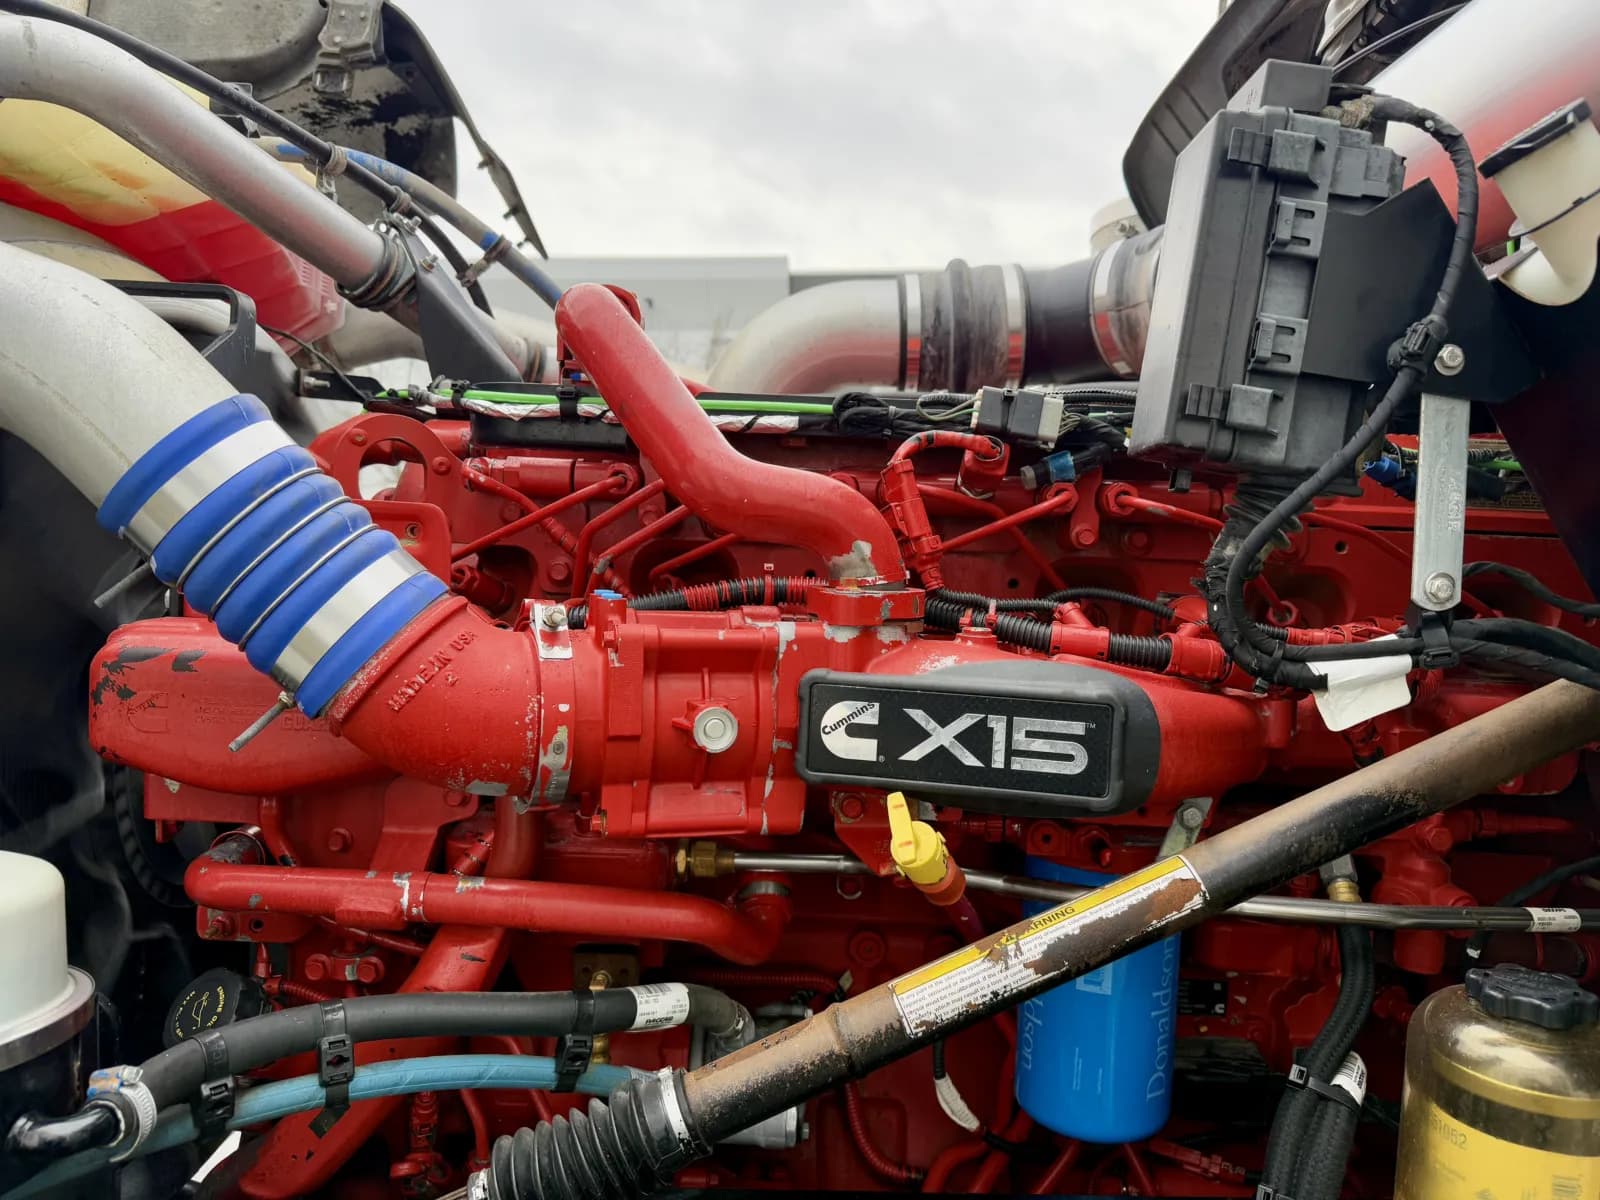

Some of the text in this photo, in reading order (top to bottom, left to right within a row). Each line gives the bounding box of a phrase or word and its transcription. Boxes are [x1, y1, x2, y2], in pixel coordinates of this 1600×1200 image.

[449, 631, 478, 652] USA
[822, 702, 875, 736] Cummins
[897, 708, 1090, 776] X15
[1026, 906, 1076, 933] ARNING
[1146, 937, 1175, 1102] Donaldson
